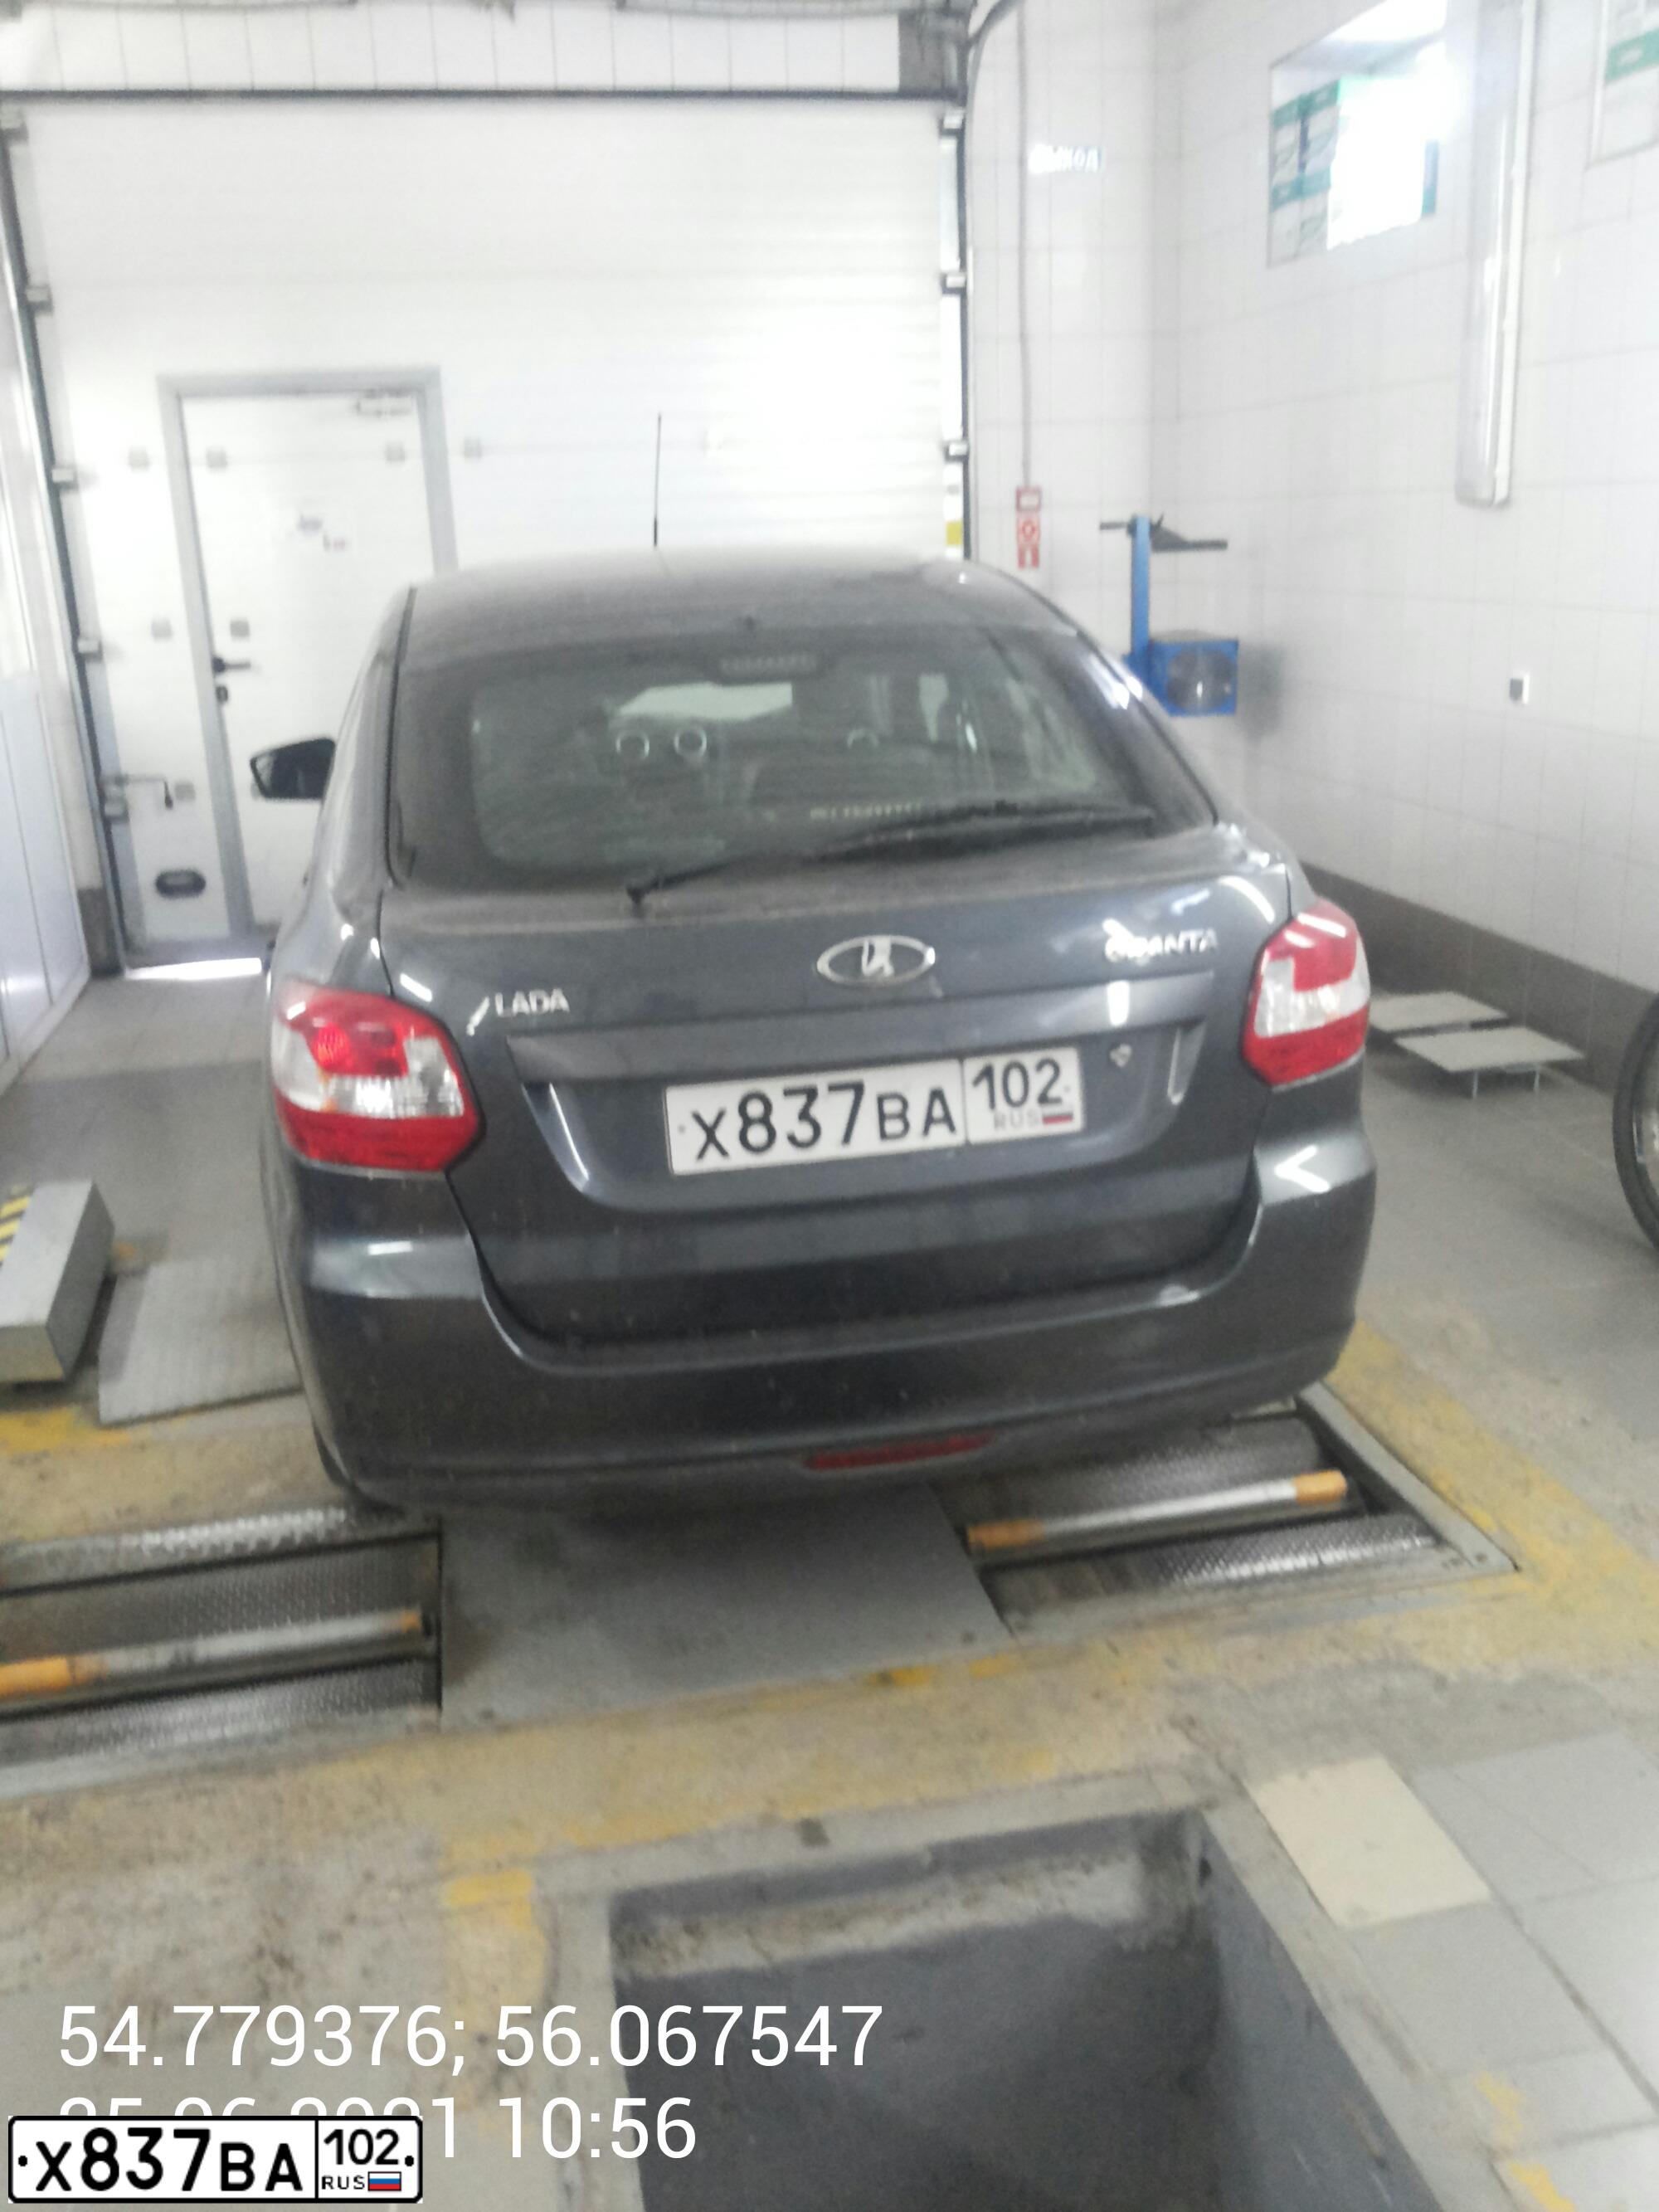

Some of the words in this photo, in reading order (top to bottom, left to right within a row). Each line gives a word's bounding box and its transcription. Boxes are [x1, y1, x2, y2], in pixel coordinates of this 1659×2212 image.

[494, 987, 570, 1017] LADA
[971, 1058, 1063, 1110] 102
[994, 1109, 1039, 1131] RUS
